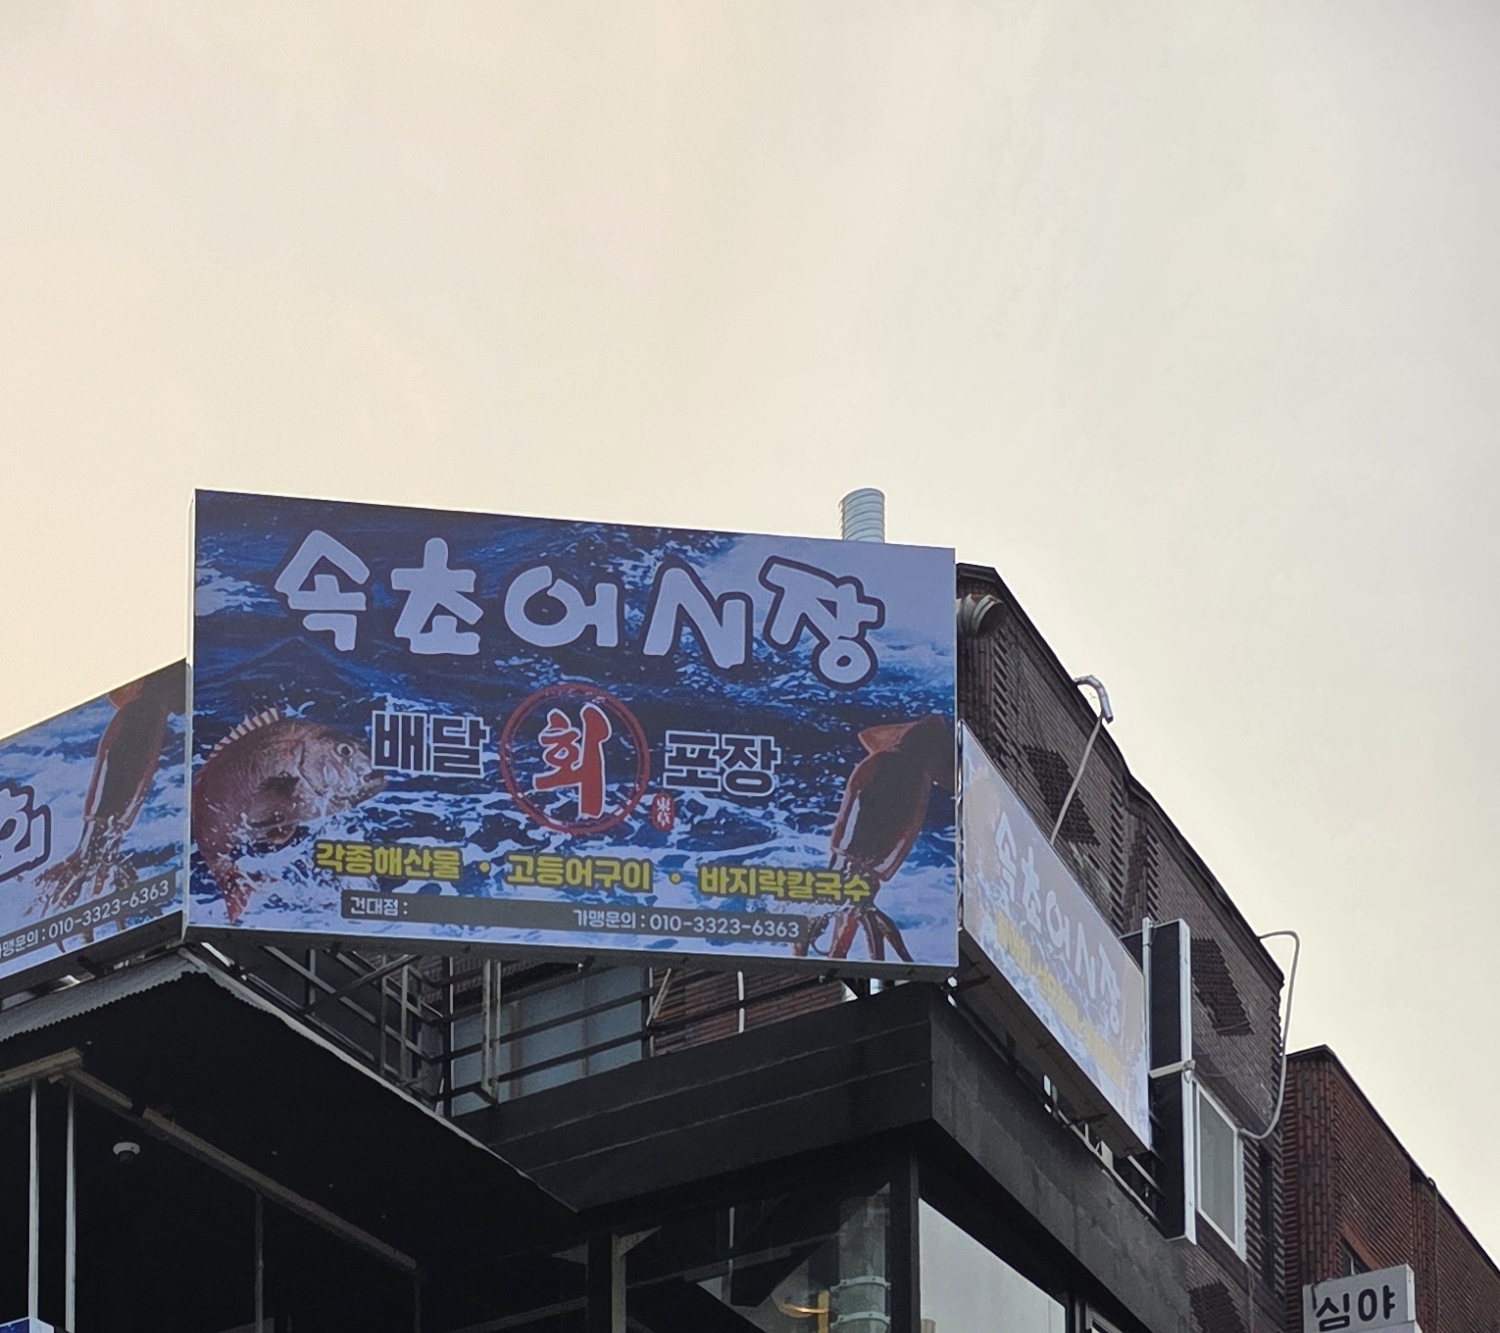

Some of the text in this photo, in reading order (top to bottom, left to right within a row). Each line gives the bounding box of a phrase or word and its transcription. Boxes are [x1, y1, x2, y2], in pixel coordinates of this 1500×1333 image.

[275, 528, 886, 688] 속초어시장
[371, 702, 780, 821] 배달 회 포장
[316, 840, 871, 904] 각종해산물 고등어구이 바지락칼국수
[48, 879, 170, 940] 010-3323-6363
[649, 913, 800, 939] 010-3323-6363
[1314, 1285, 1396, 1332] 심야
